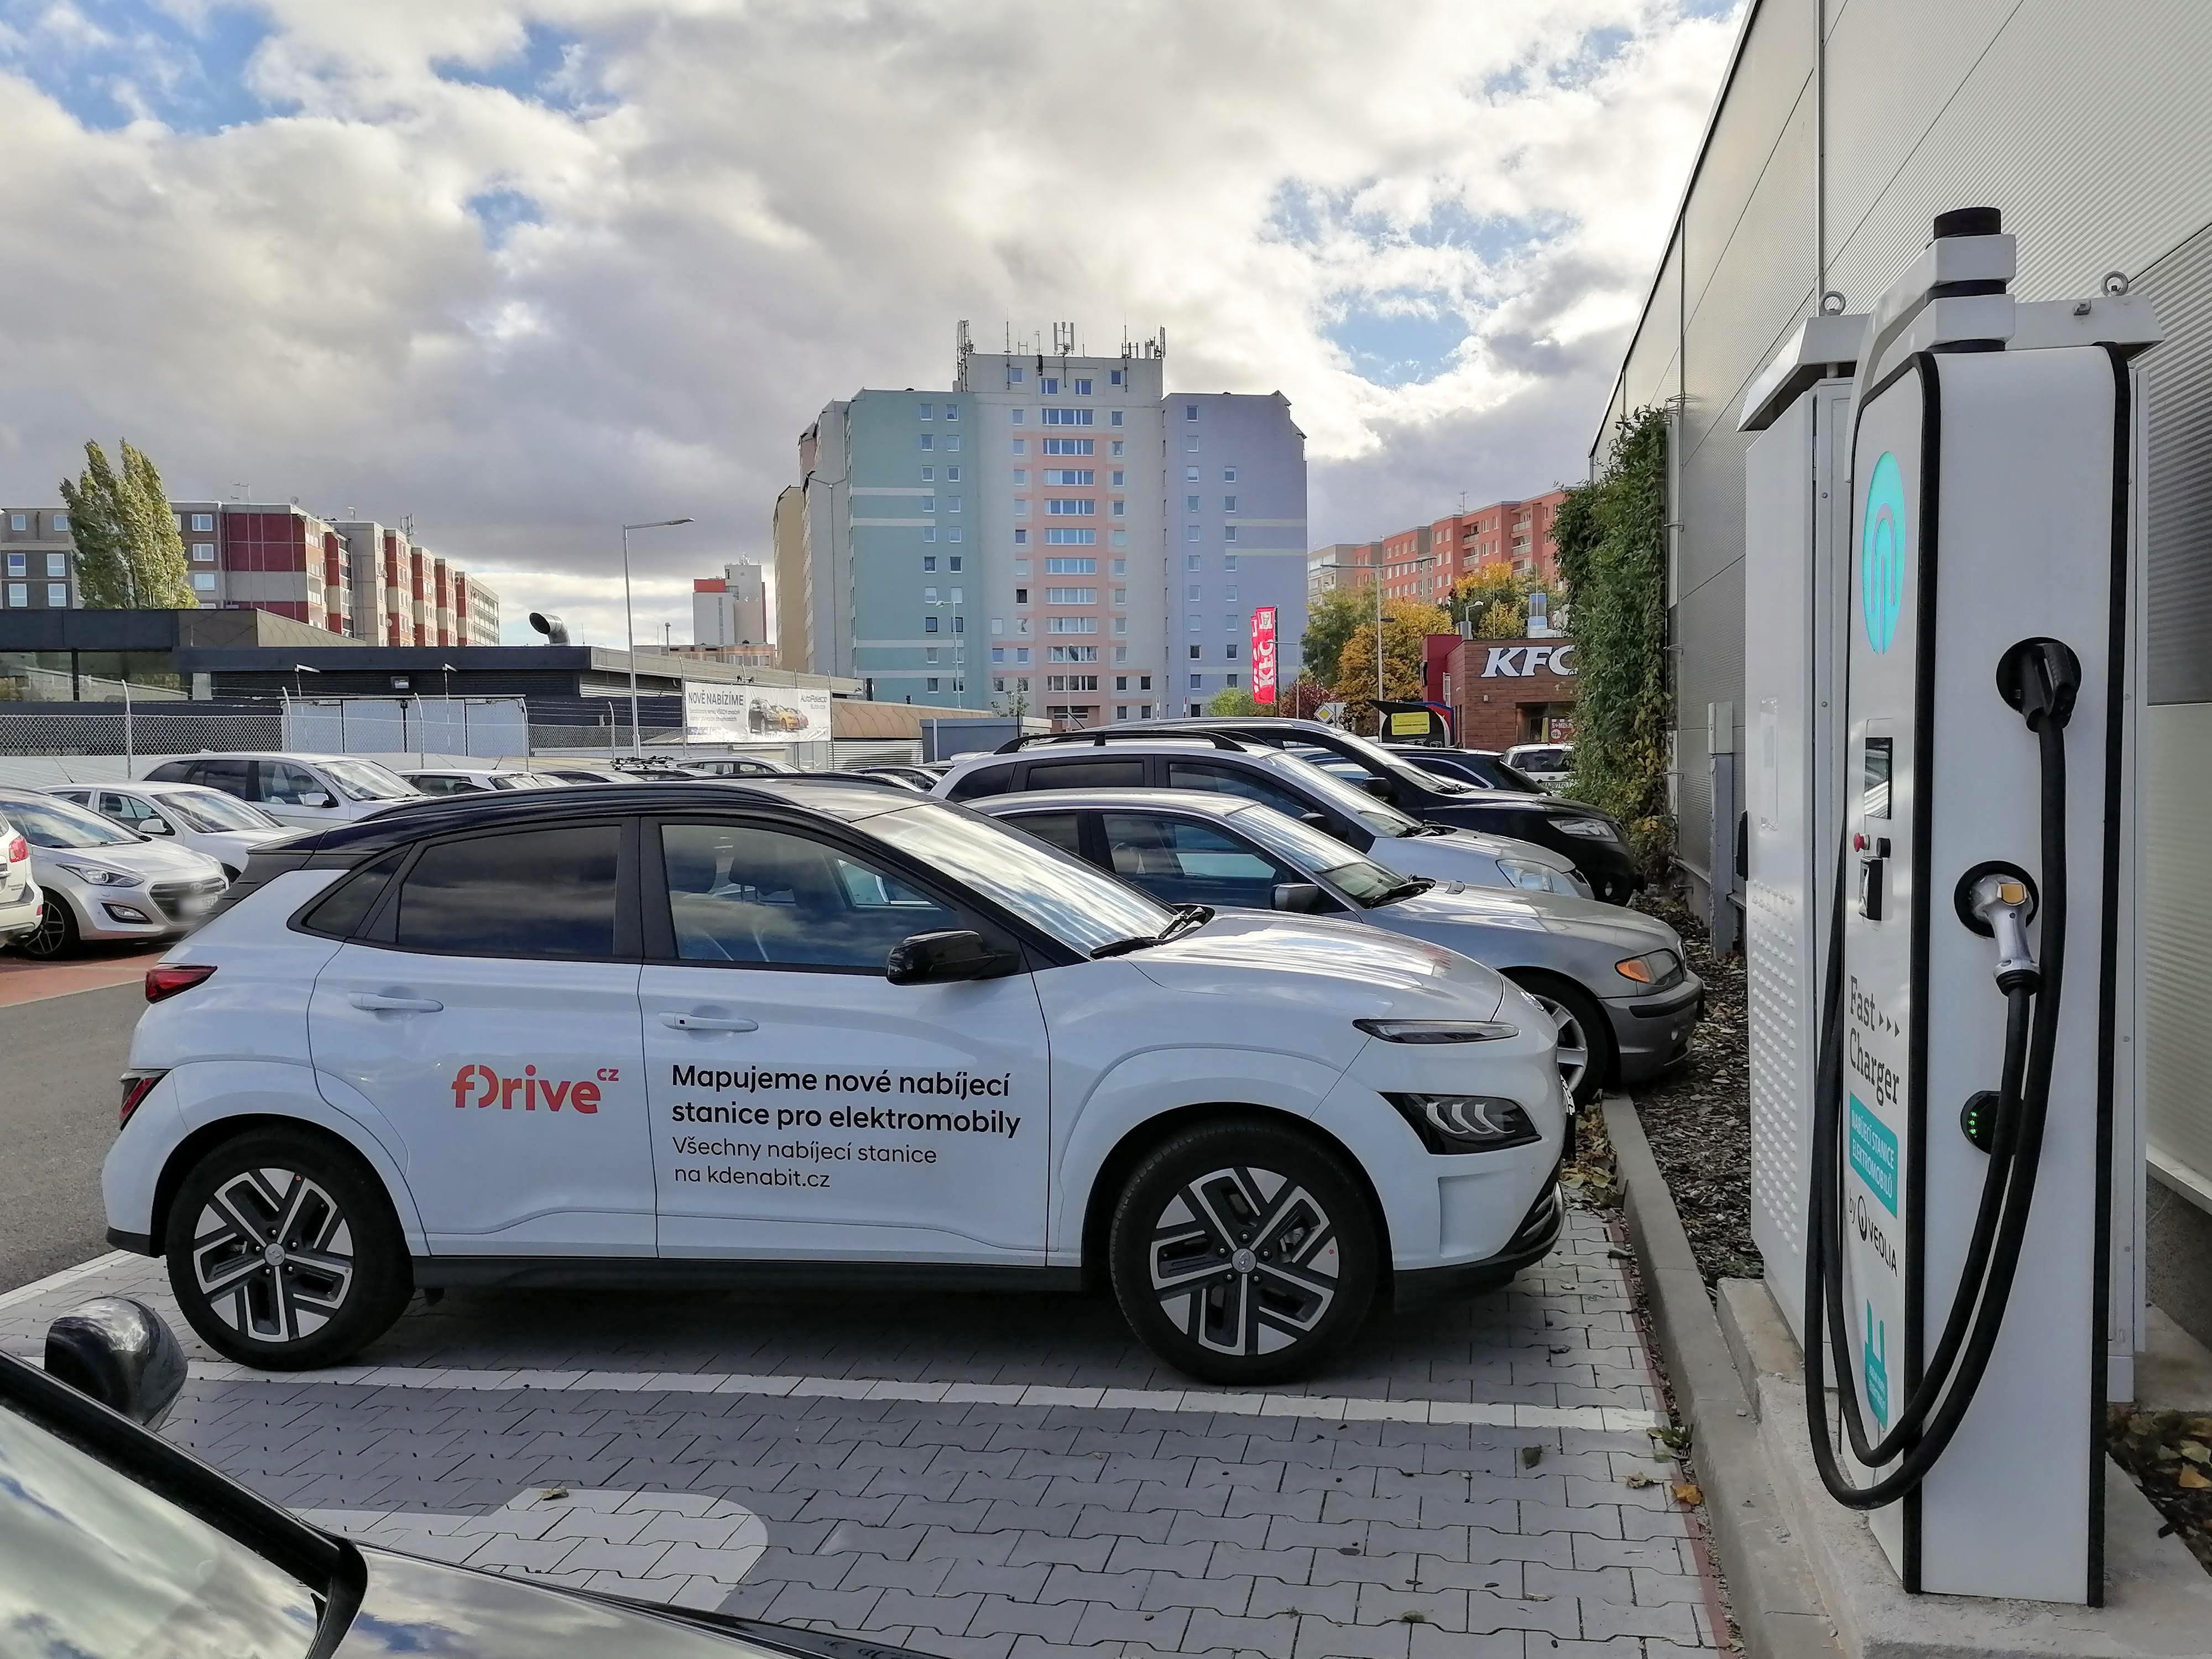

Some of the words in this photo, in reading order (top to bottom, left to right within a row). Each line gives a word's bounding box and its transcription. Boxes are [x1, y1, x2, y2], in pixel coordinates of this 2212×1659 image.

[1259, 639, 1274, 687] KFC
[1480, 645, 1578, 677] KFC
[688, 690, 706, 704] NOVĚ
[707, 691, 744, 706] NABÍZÍME
[1850, 975, 1875, 1031] Fast
[672, 1065, 817, 1093] Mapujeme
[826, 1070, 891, 1093] nové
[900, 1071, 1011, 1100] nabíjecí
[1850, 1027, 1899, 1106] Charger
[672, 1101, 769, 1124] stanice
[778, 1109, 822, 1130] pro
[830, 1106, 1021, 1139] elektromobily
[672, 1136, 761, 1161] Všechny
[768, 1141, 852, 1163] nabíjecí
[858, 1144, 937, 1164] stanice
[1872, 1131, 1894, 1170] STANICE
[675, 1168, 700, 1182] na
[708, 1166, 830, 1187] kdenabit.cz
[1849, 1190, 1857, 1224] by
[1867, 1217, 1897, 1277] VEOLIA
